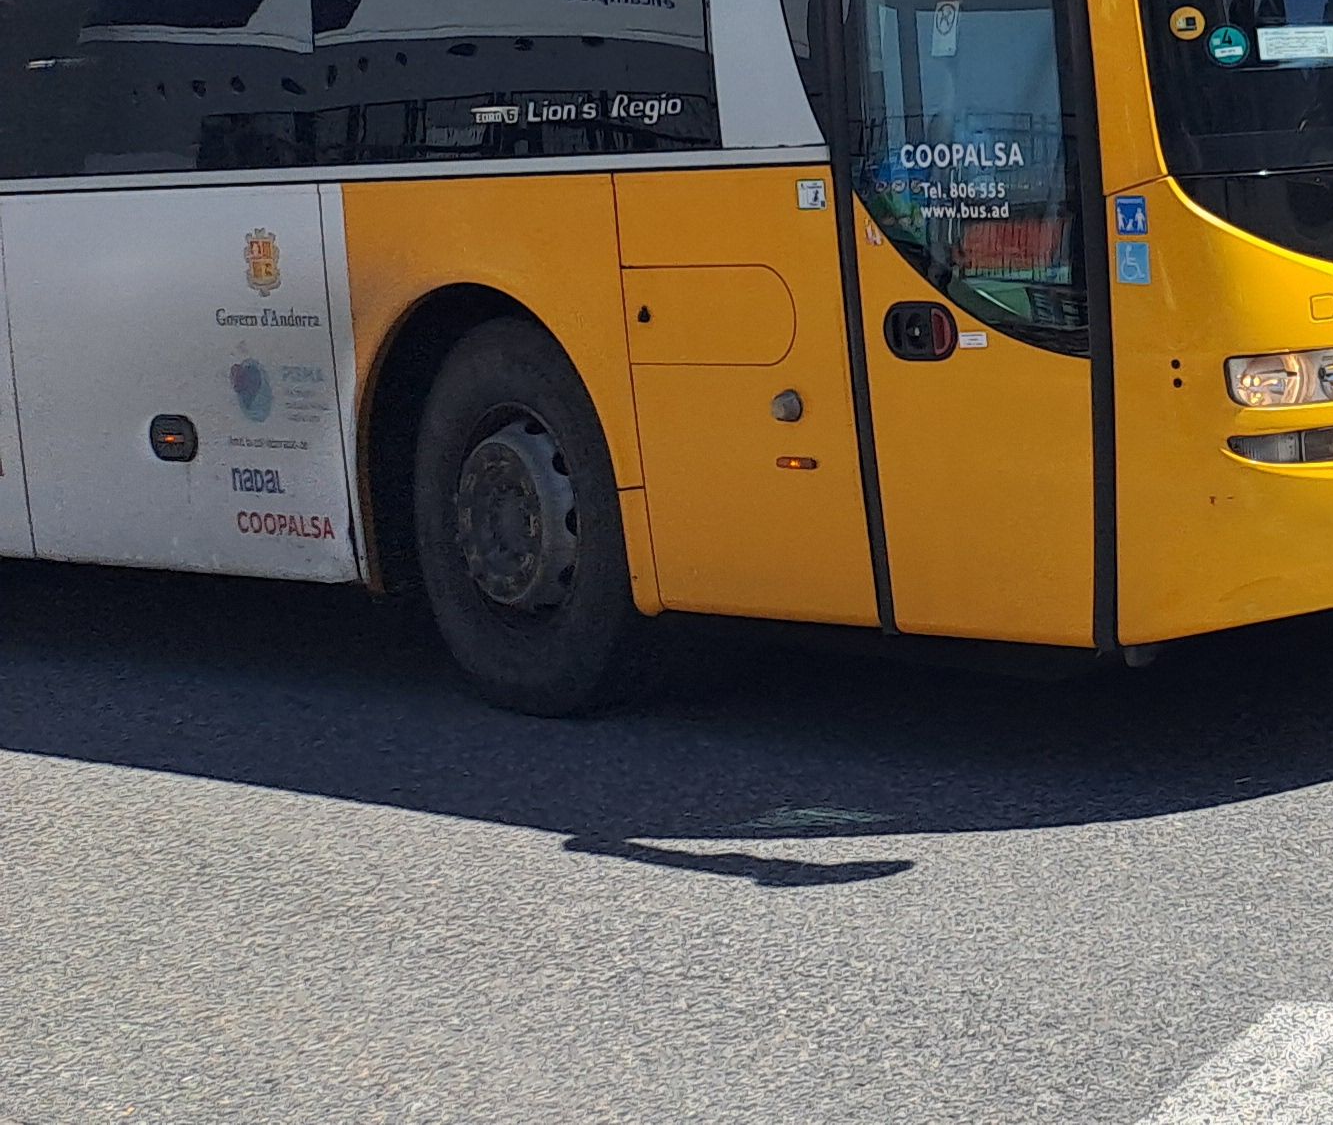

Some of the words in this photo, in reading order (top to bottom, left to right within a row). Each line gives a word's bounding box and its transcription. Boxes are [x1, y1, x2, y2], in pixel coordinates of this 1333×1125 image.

[527, 96, 597, 122] Lion's
[611, 93, 682, 124] Regio
[900, 142, 1025, 168] COOPALSA
[920, 182, 947, 199] Tel.
[950, 182, 976, 199] 806
[979, 182, 1006, 198] 555
[921, 202, 1010, 219] www.bus.ad
[215, 308, 258, 326] Govern
[261, 306, 322, 327] d'Andorra
[237, 510, 336, 540] COOPALSA
